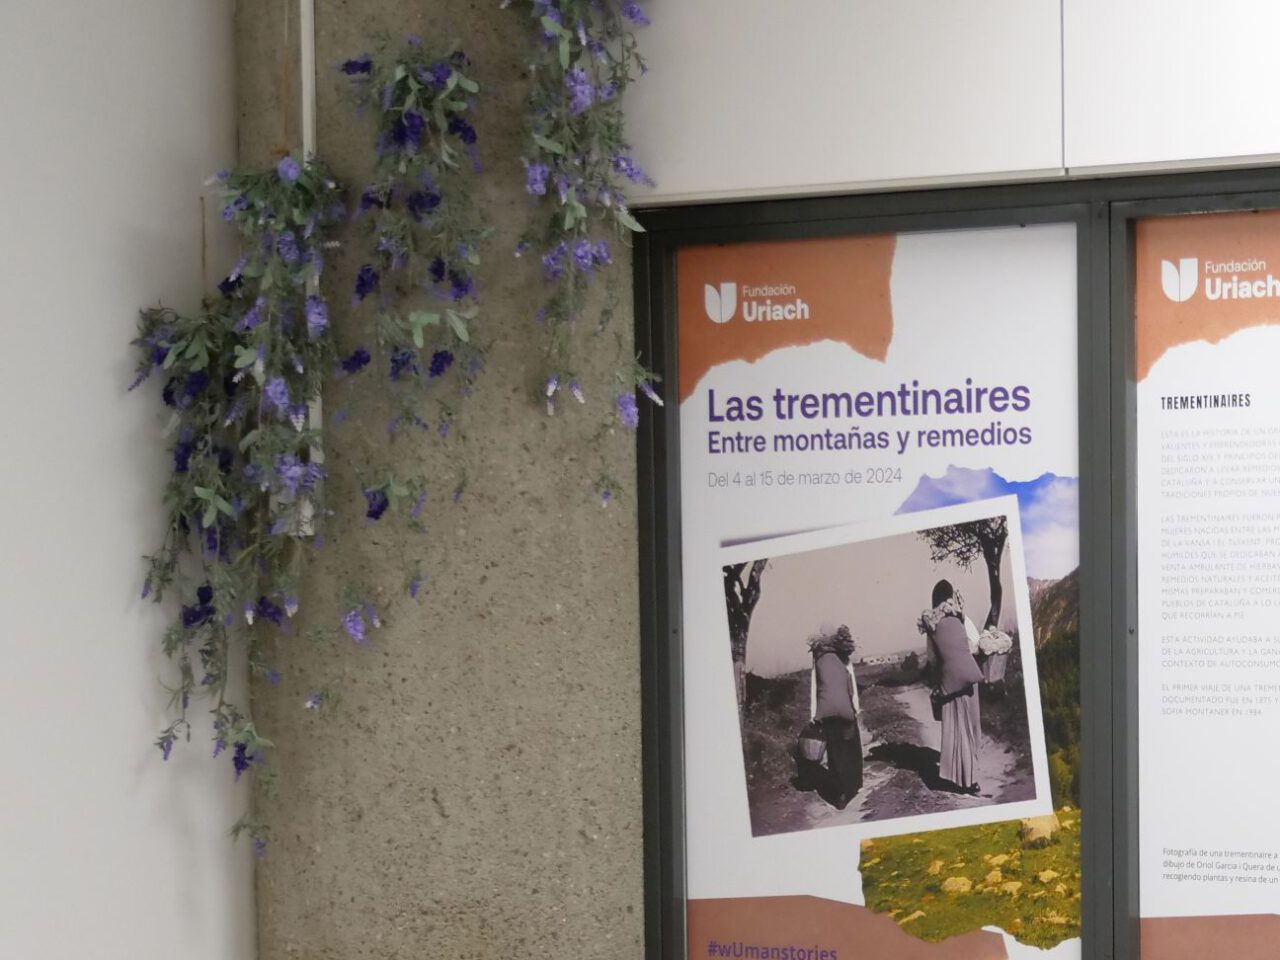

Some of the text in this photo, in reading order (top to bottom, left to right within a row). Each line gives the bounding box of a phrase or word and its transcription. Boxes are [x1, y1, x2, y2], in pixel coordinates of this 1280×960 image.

[1205, 258, 1266, 274] Fundación
[743, 284, 796, 297] Fundación
[1205, 274, 1280, 300] Uriach
[743, 299, 809, 321] Uriach
[708, 378, 1031, 422] Las trementinaires
[1161, 393, 1251, 410] TREMENTINAIRES
[708, 422, 1032, 454] Entre montañas y remedios
[708, 468, 902, 488] Del 4 al 15 de marzo de 2024
[1223, 850, 1272, 859] trementinaire
[1242, 862, 1265, 873] Quera
[1163, 872, 1202, 883] recogiendo
[1202, 873, 1228, 884] plantas
